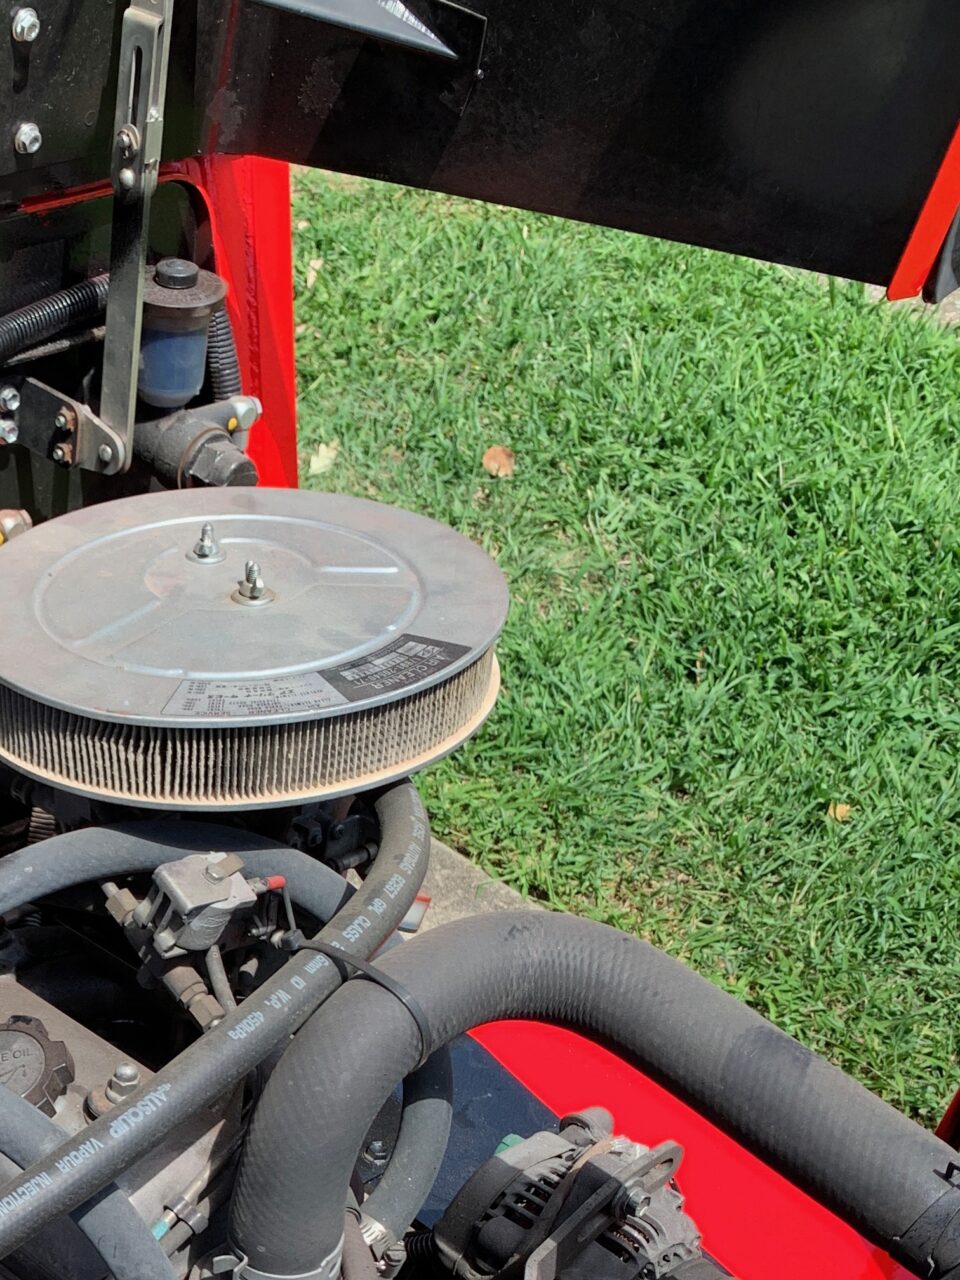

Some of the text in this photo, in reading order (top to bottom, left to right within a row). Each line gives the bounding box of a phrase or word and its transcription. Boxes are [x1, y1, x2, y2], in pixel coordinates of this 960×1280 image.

[366, 896, 389, 916] GPL
[341, 913, 372, 945] CLASS
[226, 1007, 267, 1045] 450kPa
[12, 1048, 33, 1060] OIL
[52, 1133, 105, 1178] VAPOUR
